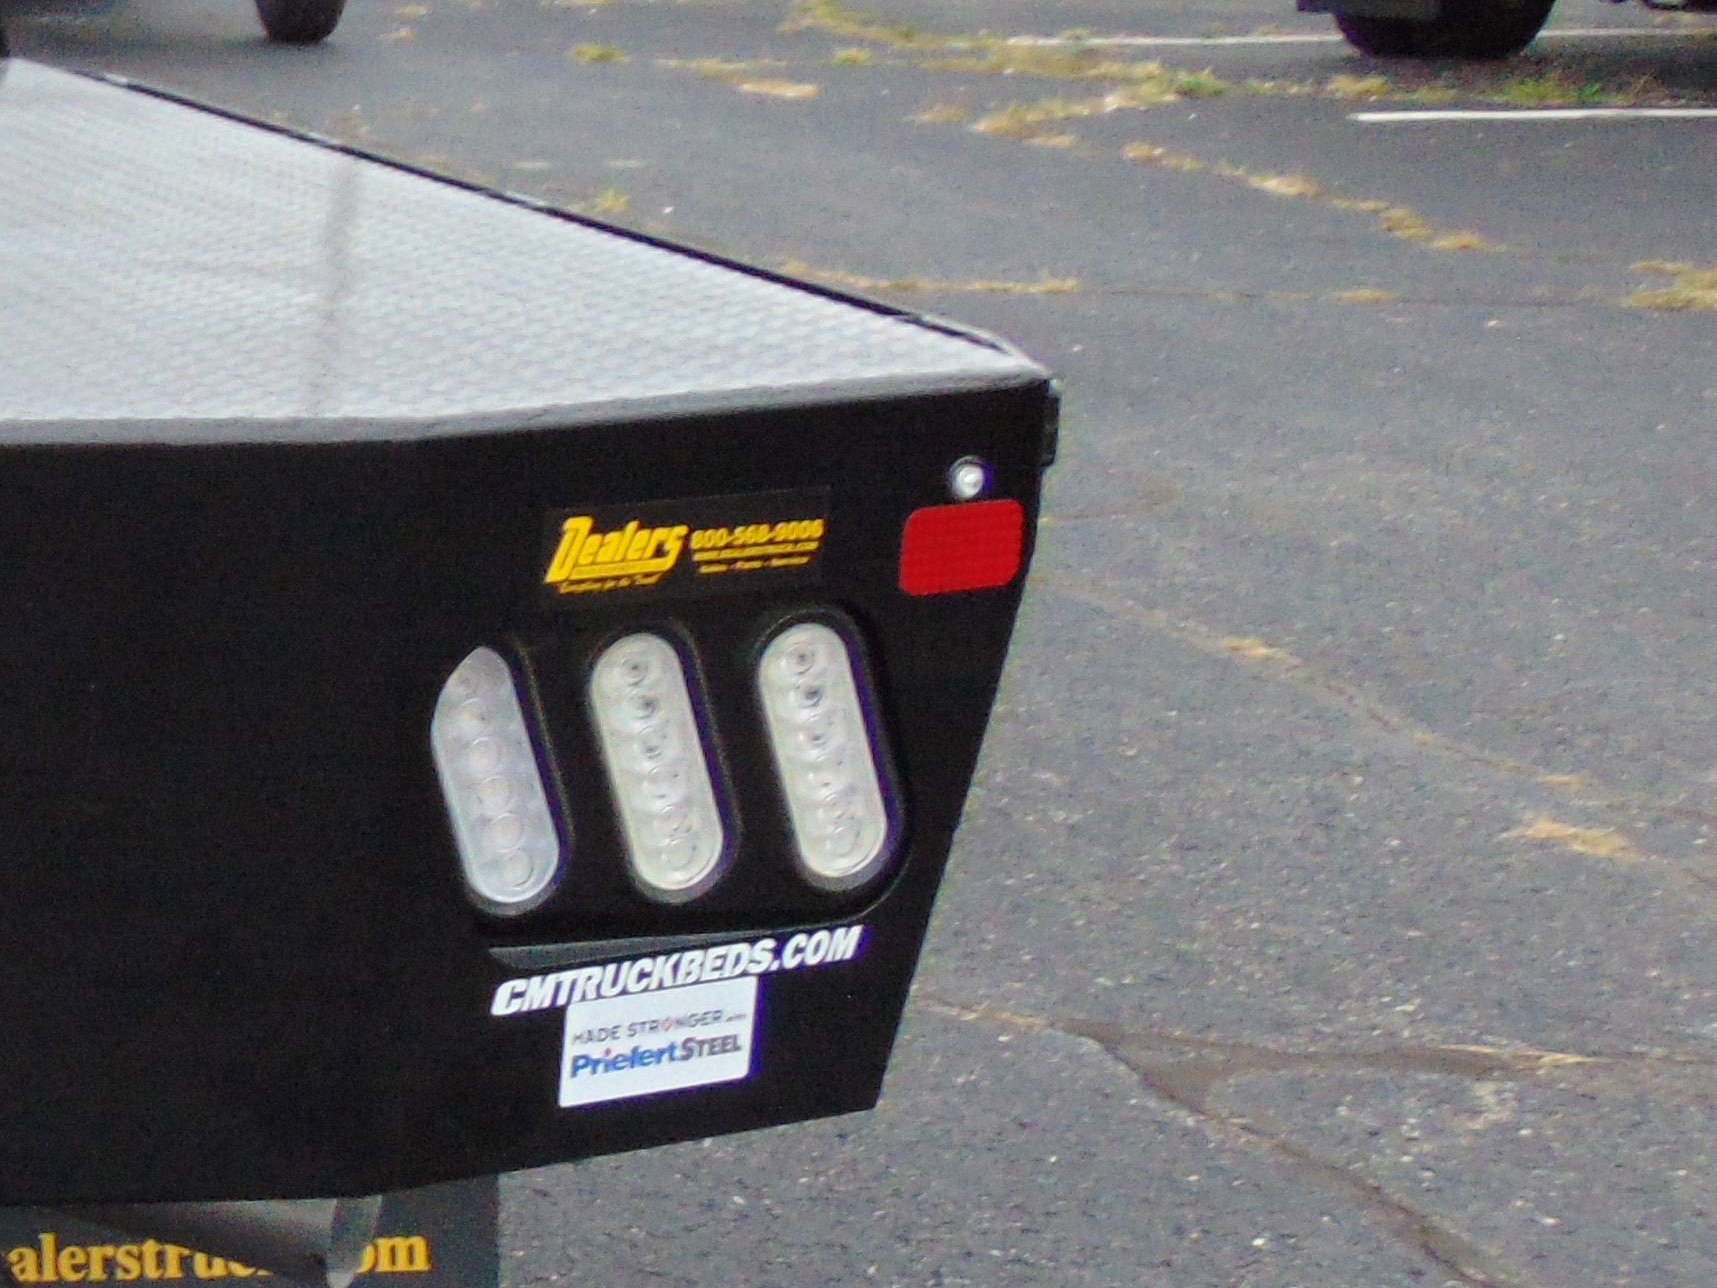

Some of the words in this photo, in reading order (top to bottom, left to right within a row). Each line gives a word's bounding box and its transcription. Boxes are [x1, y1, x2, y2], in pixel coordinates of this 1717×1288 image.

[545, 516, 689, 583] Dealers
[490, 924, 864, 1017] CMTRUCKBEDS.COM
[573, 1025, 622, 1045] MADE
[627, 1010, 723, 1038] STRONGER
